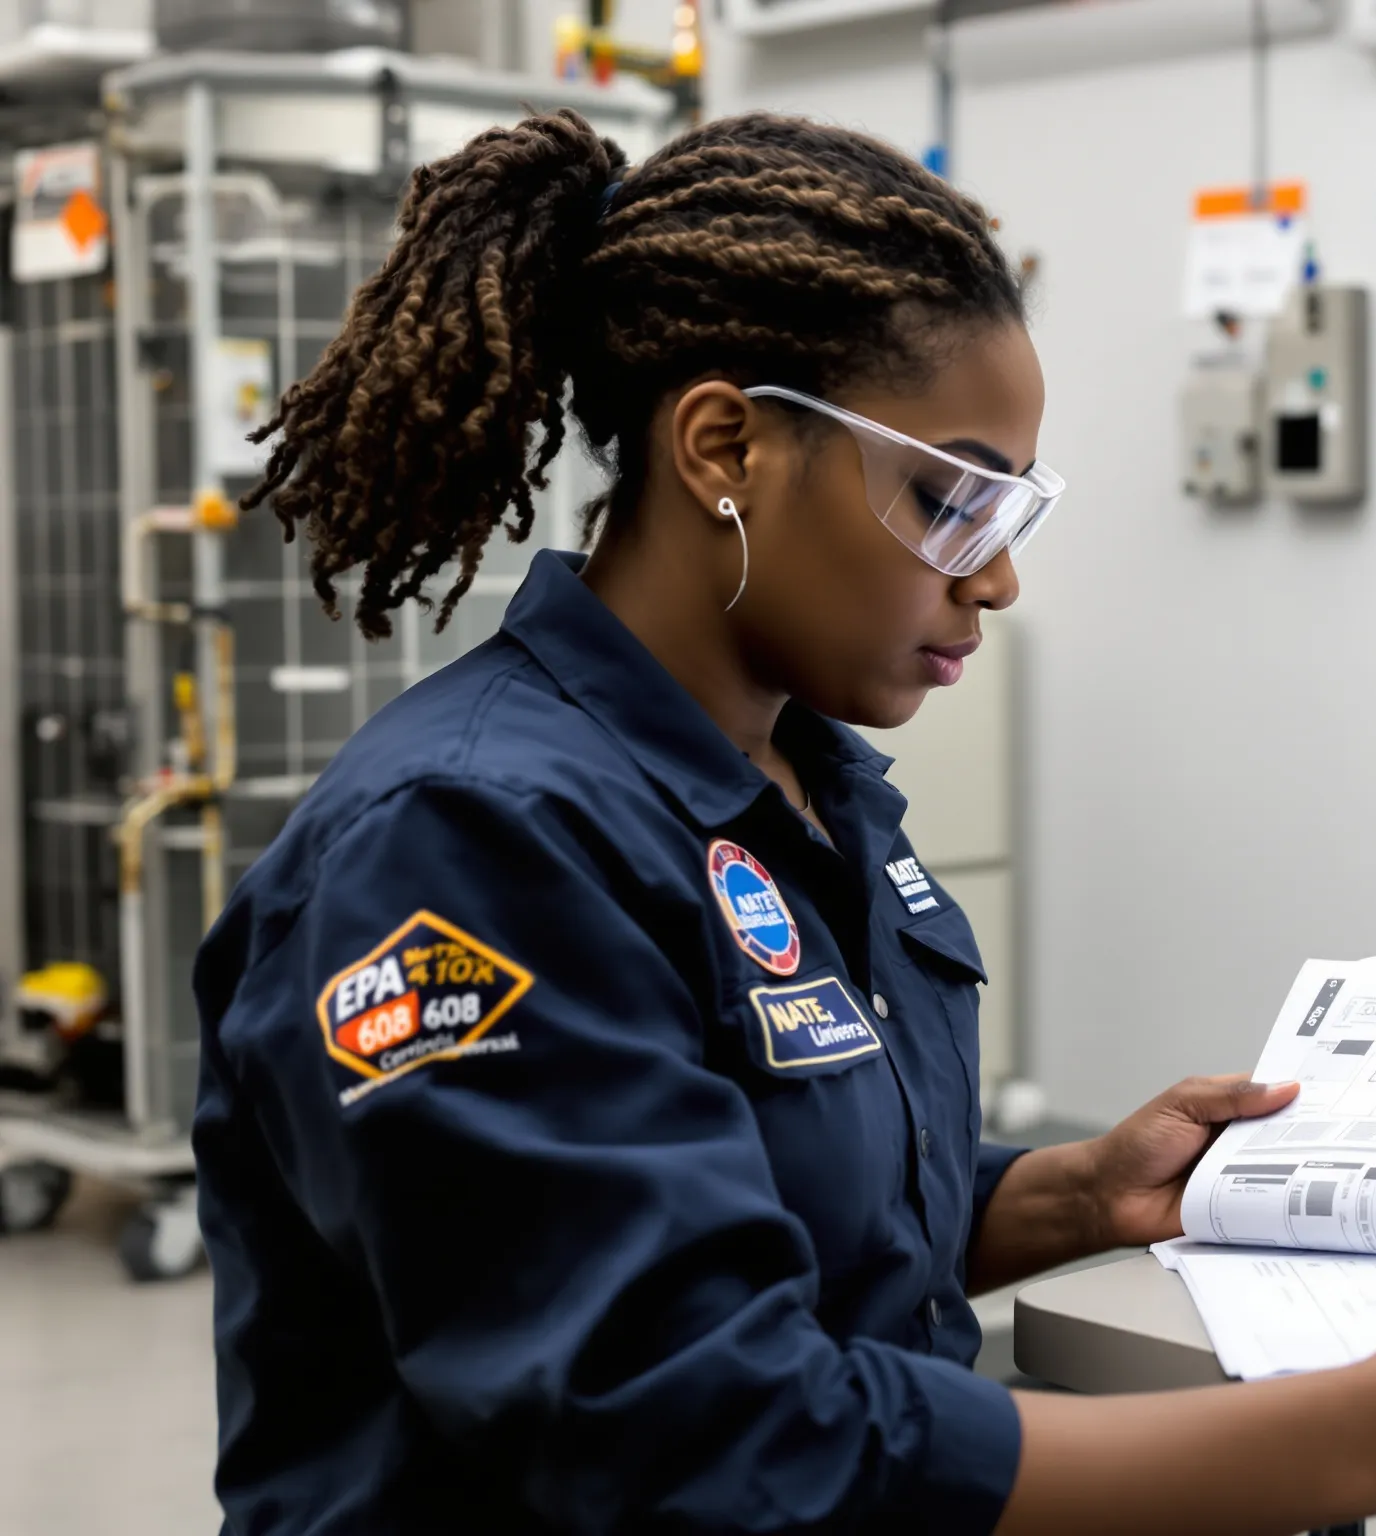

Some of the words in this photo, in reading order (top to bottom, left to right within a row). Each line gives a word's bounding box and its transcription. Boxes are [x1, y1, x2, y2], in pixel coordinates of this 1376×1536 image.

[335, 955, 406, 1022] EPA
[357, 1005, 412, 1053] 608
[422, 992, 481, 1030] 608
